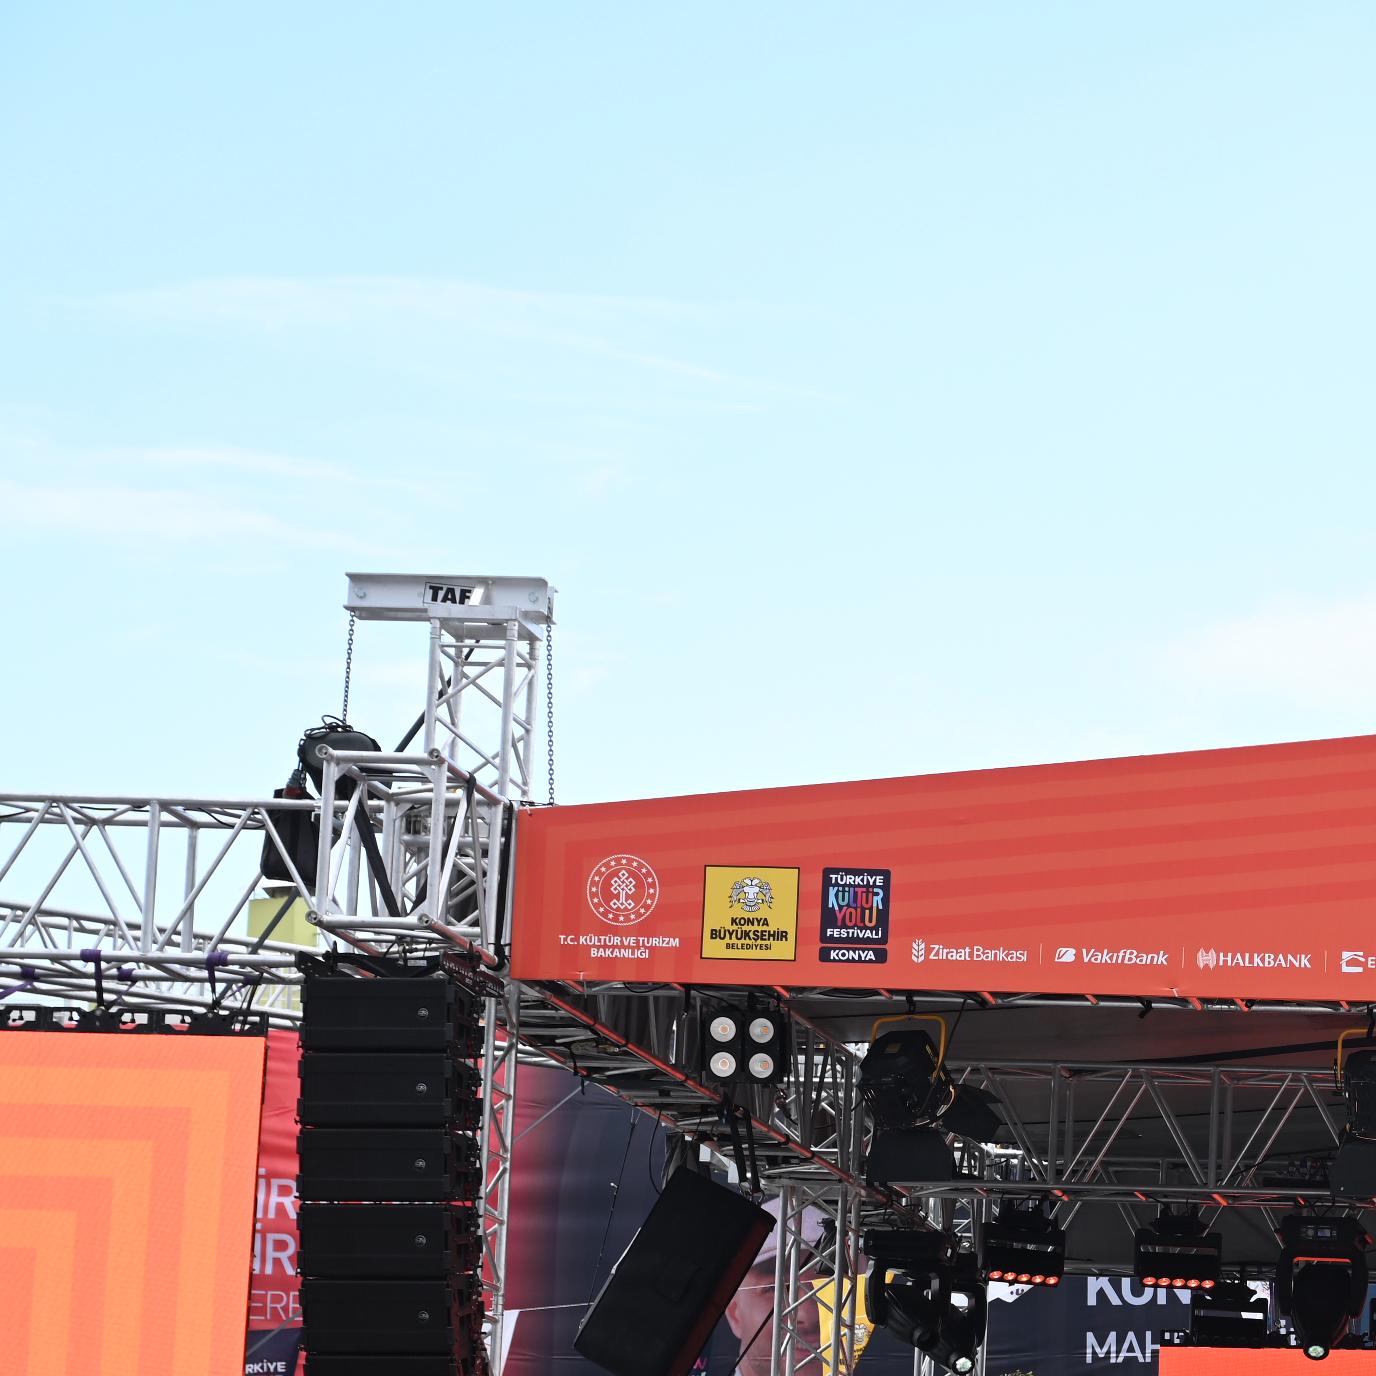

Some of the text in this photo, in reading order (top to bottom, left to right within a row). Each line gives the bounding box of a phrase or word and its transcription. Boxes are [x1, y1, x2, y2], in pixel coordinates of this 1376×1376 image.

[429, 584, 474, 605] TAF
[829, 872, 884, 886] TÜRKİYE
[828, 886, 884, 910] KÜLTÜR
[730, 916, 770, 927] KONYA
[835, 906, 877, 928] YOLU
[709, 927, 789, 943] BÜYÜKŞEHİR
[826, 926, 882, 939] FESTİVALİ
[559, 934, 679, 948] T.C. KÜLTÜR VE TURİZM
[725, 941, 772, 952] BELEDİYESİ
[590, 946, 649, 959] BAKANLIĞI
[830, 949, 876, 961] KONYA
[929, 944, 1028, 962] Ziraat Bankası
[1081, 947, 1169, 965] VakıfBank
[1218, 952, 1312, 968] HALKBANK
